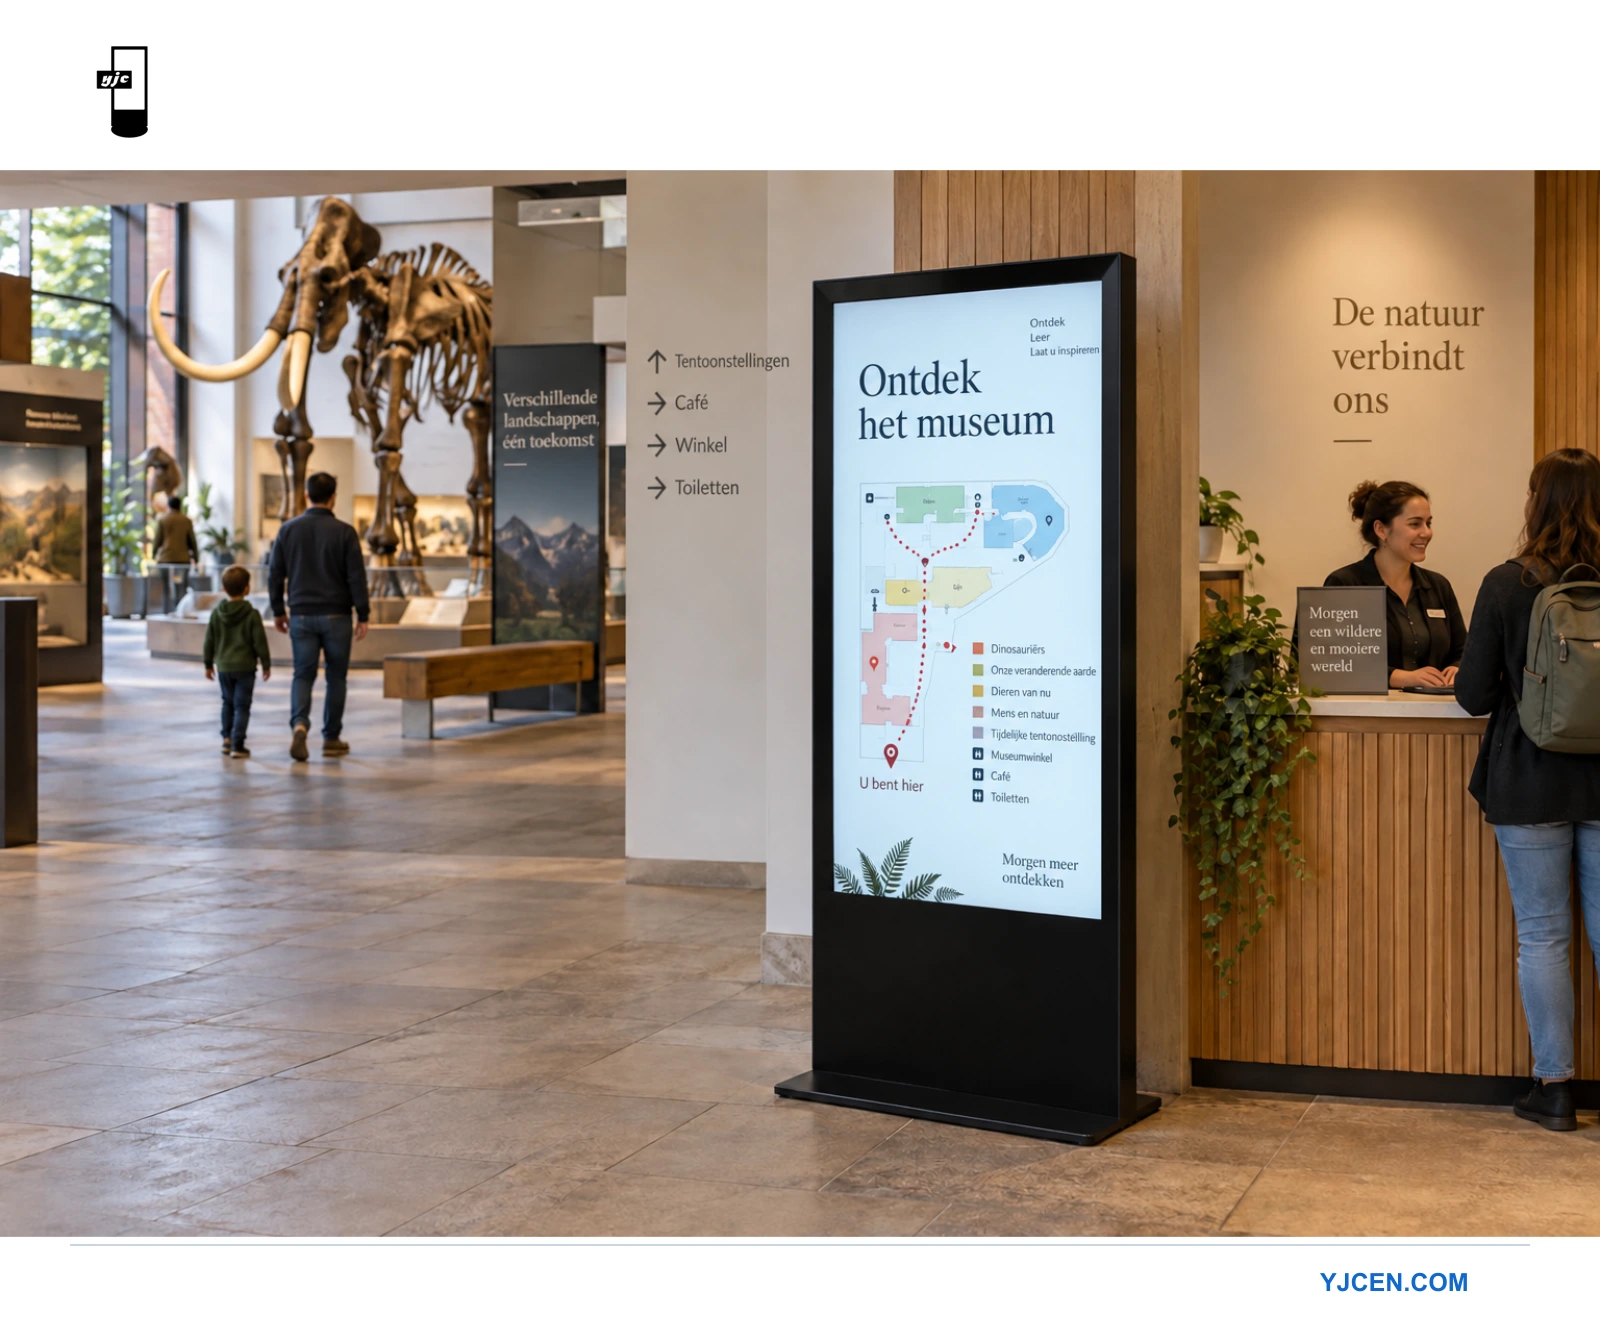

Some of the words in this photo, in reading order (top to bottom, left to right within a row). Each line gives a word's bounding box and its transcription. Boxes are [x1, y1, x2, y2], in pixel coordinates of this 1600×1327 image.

[1332, 297, 1375, 327] De
[1384, 299, 1485, 327] natuur
[1029, 316, 1066, 328] Ontdek
[1030, 333, 1051, 343] Leer
[1030, 347, 1048, 357] Laat
[1050, 348, 1056, 356] u
[1057, 345, 1100, 358] inspireren
[1331, 339, 1465, 371] verbindt
[674, 352, 790, 372] Tentoonstellingen
[859, 358, 983, 397] Ontdek
[503, 388, 598, 408] Verschillende
[674, 393, 709, 411] Café
[1333, 392, 1389, 414] ons
[503, 411, 600, 430] landschappen,
[858, 406, 908, 440] het
[916, 410, 1056, 439] museum
[502, 434, 527, 450] één
[529, 432, 595, 449] toekomst
[674, 435, 728, 453] Winkel
[674, 478, 740, 496] Toiletten
[1309, 606, 1359, 623] Morgen
[1309, 626, 1332, 638] een
[1334, 624, 1382, 638] wildere
[991, 643, 1046, 655] Dinosauriërs
[1310, 645, 1325, 655] en
[1329, 642, 1380, 655] mooiere
[991, 665, 1013, 676] Onze
[1014, 665, 1072, 677] veranderende
[1073, 666, 1097, 677] aarde
[1310, 659, 1353, 672] wereld
[991, 686, 1020, 697] Dieren
[1022, 689, 1038, 698] van
[1040, 689, 1051, 698] nu
[991, 708, 1016, 719] Mens
[1017, 710, 1029, 719] en
[1030, 709, 1060, 720] natuur
[990, 728, 1028, 742] Tijdelijke
[991, 750, 1053, 764] Museumwinkel
[859, 776, 869, 790] U
[872, 777, 899, 791] bent
[901, 779, 925, 792] hier
[990, 770, 1011, 782] Café
[990, 791, 1030, 804] Toiletten
[1002, 853, 1047, 870] Morgen
[1049, 858, 1079, 871] meer
[1002, 872, 1065, 889] ontdekken
